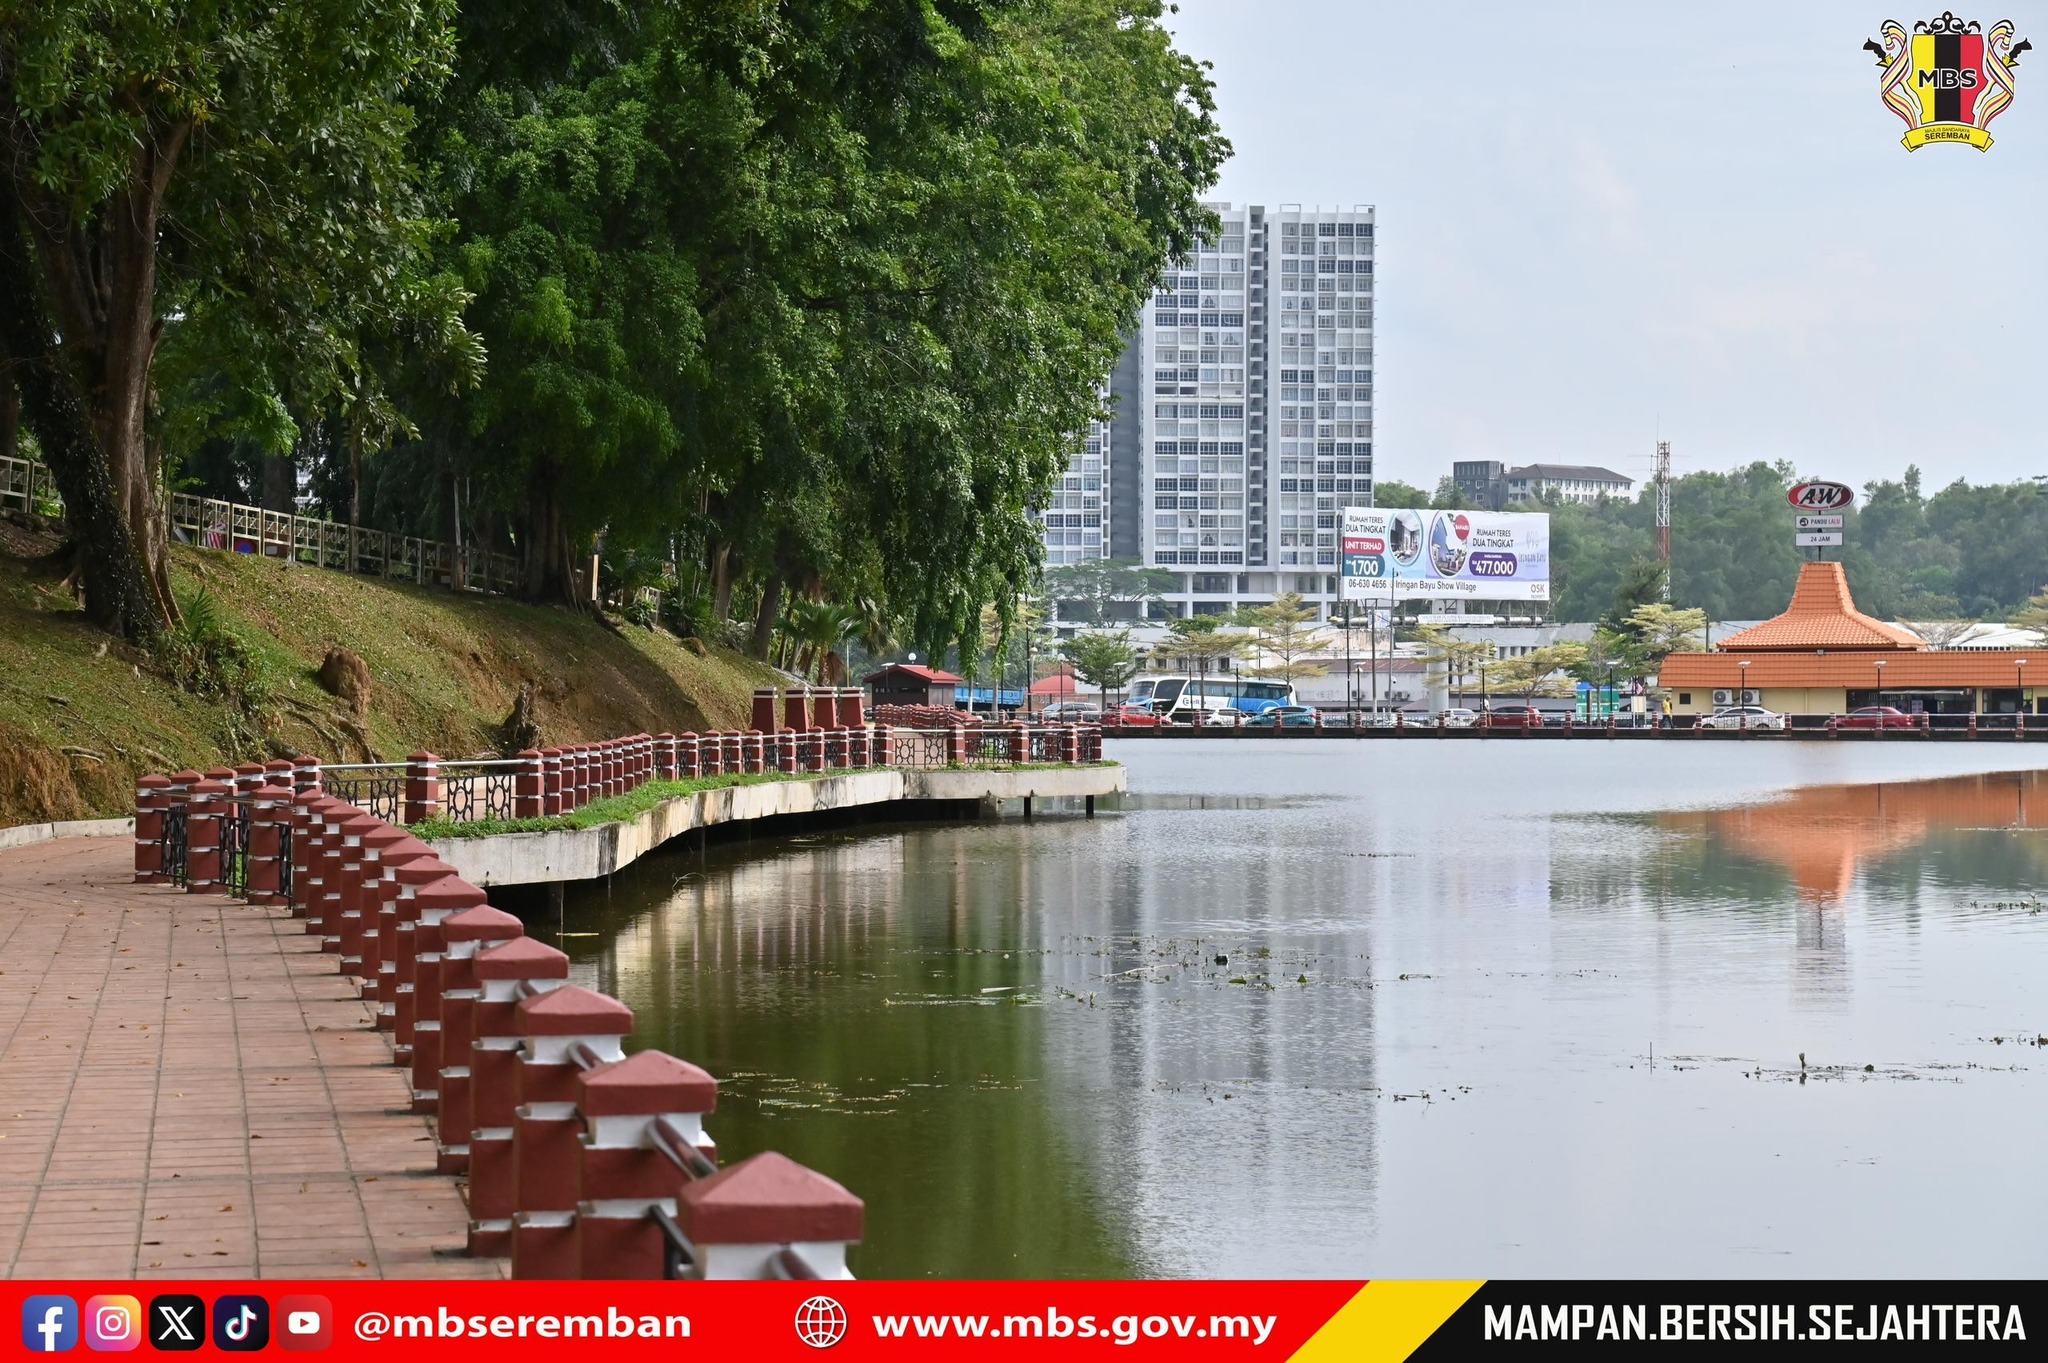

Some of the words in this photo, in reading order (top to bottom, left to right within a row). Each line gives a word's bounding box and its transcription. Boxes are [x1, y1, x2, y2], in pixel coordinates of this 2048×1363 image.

[1349, 515, 1368, 523] RUMAH
[1345, 524, 1359, 532] DUA
[1360, 525, 1386, 534] TINGKAT
[1496, 529, 1511, 537] TERES
[1345, 540, 1359, 549] UNIT
[1359, 541, 1382, 550] TERHAD
[1472, 538, 1486, 547] DUA
[1487, 539, 1514, 548] TINGKAT
[1348, 579, 1370, 588] 06-630
[1371, 580, 1387, 589] 4656
[1419, 581, 1436, 591] Bayu
[1437, 581, 1455, 590] Show
[1457, 582, 1476, 592] Village
[1530, 584, 1545, 593] OSK
